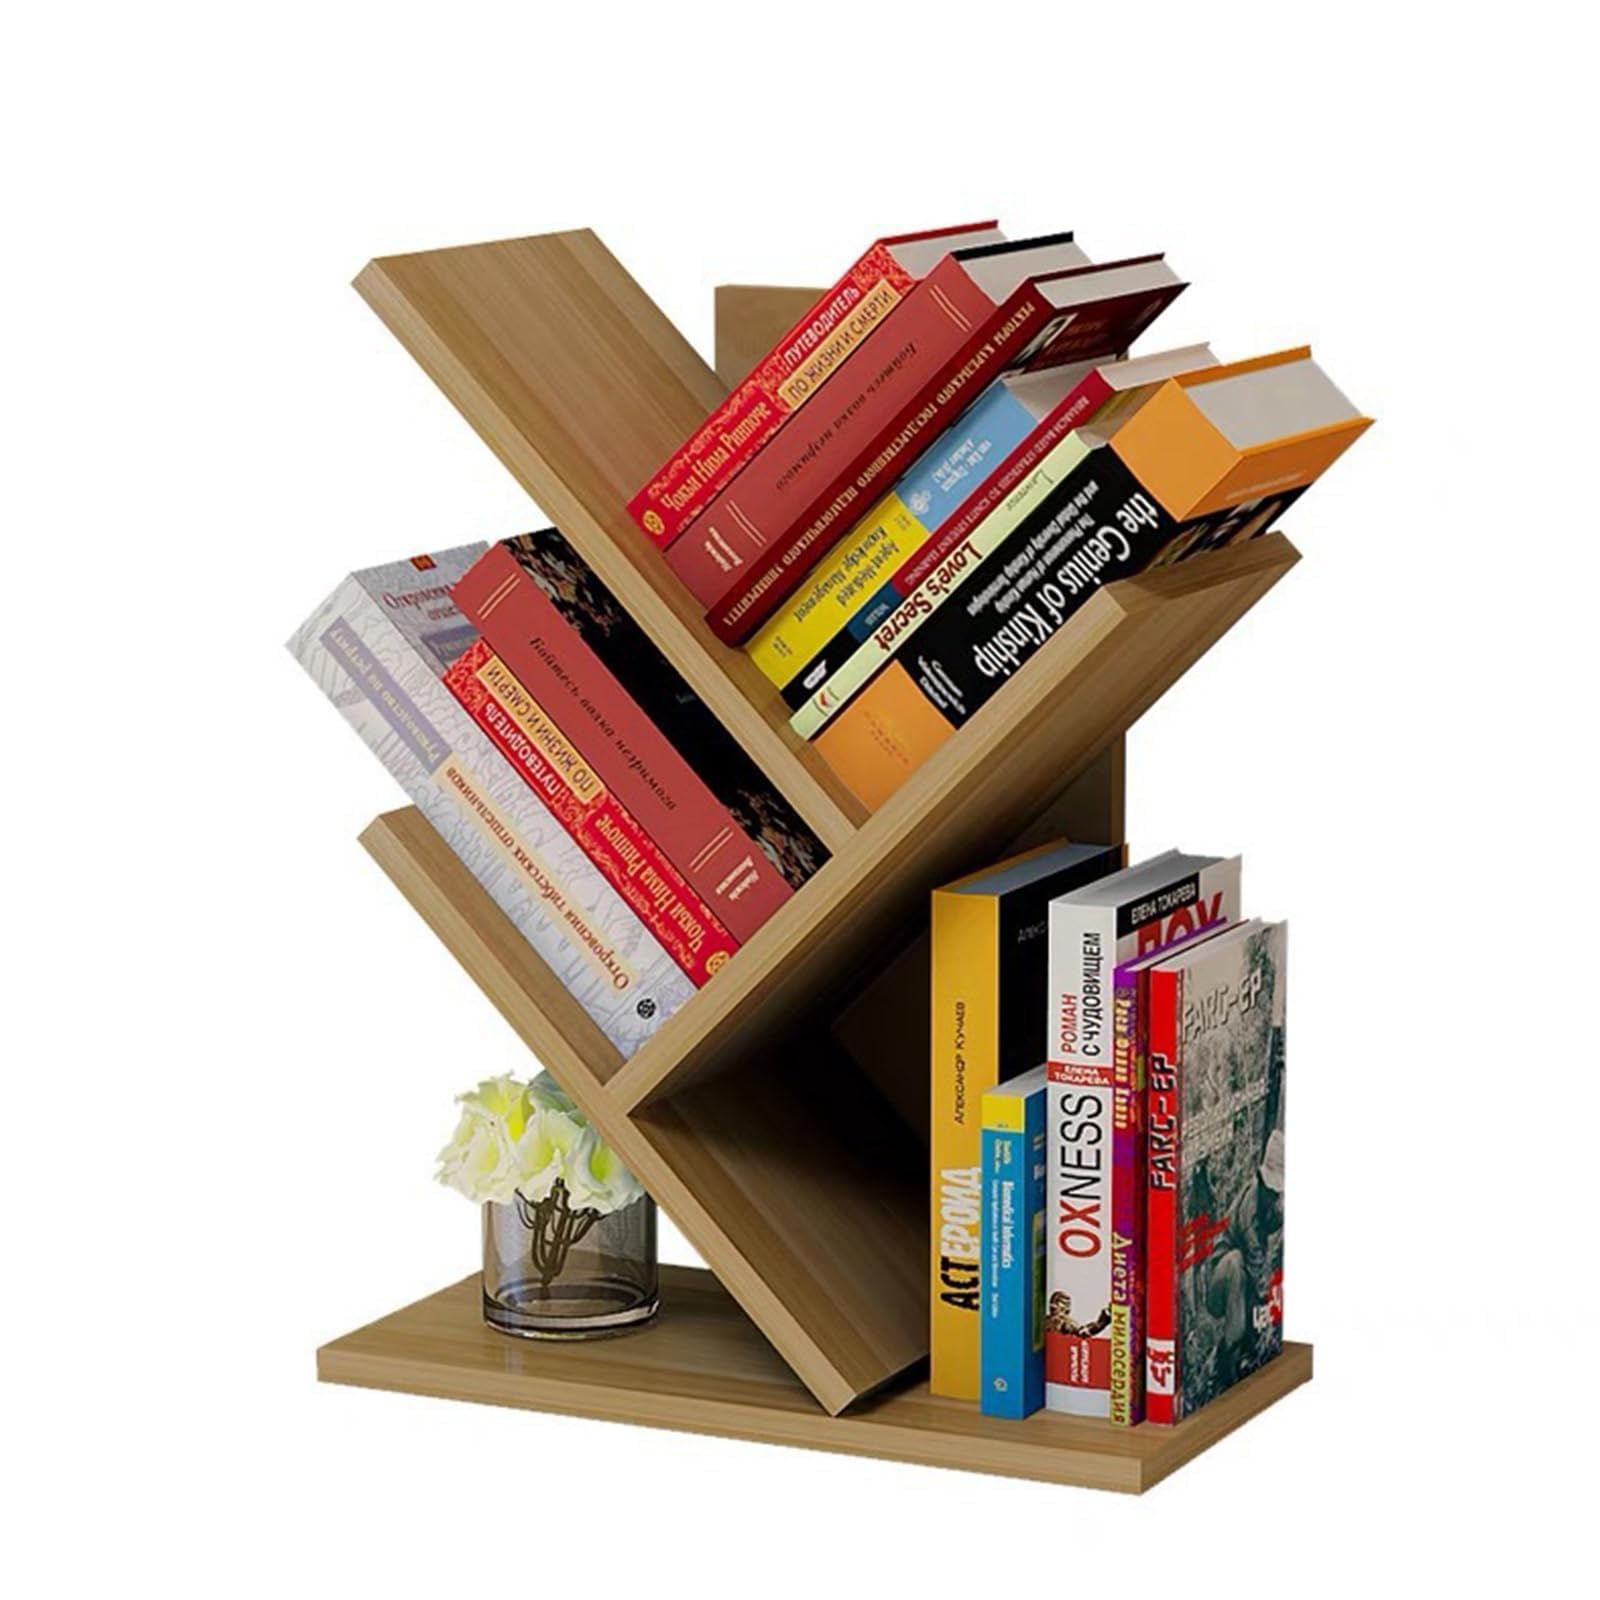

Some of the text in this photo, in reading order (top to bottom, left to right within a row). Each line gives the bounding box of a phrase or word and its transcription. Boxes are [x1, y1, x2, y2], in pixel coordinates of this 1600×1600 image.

[780, 283, 861, 368] ПУТЕВОДИТЕЛЬ
[787, 289, 893, 399] ПО ЖИЗНИ И СМЕРТИ
[991, 300, 1035, 345] РЕКТОРЫ
[933, 341, 995, 406] КАРЕЛЬСКОГО
[691, 442, 730, 482] Нима
[719, 398, 772, 452] Ринпоче
[853, 401, 938, 489] ГОСУДАРСТВЕННОГО
[779, 484, 858, 566] ПЕДАГОГИЧЕСКОГО
[1113, 492, 1163, 542] the
[721, 562, 783, 626] УНИВЕРСИТЕТА
[924, 541, 981, 600] Love's
[1033, 580, 1073, 620] of
[1056, 521, 1134, 600] Genius
[872, 590, 933, 653] Secret
[967, 599, 1052, 685] Kinship
[526, 634, 586, 699] Бойтесь
[576, 695, 617, 739] волка
[480, 701, 563, 795] ПУТЕВОДИТЕЛЬ
[485, 665, 594, 791] ПО ЖИЗНИ И СМЕРТИ
[442, 766, 635, 990] Откровения тибетских отшельников
[589, 813, 646, 875] Ринпоче
[633, 865, 676, 911] Нима
[1131, 881, 1196, 925] ЕЛЕНА ТОКАРЕВА
[1061, 993, 1077, 1054] РОМАН
[1082, 932, 1103, 1057] С ЧУДОВИЩЕМ
[940, 1168, 980, 1311] АСТЕРОИД
[1111, 1232, 1132, 1425] Диета милосердия
